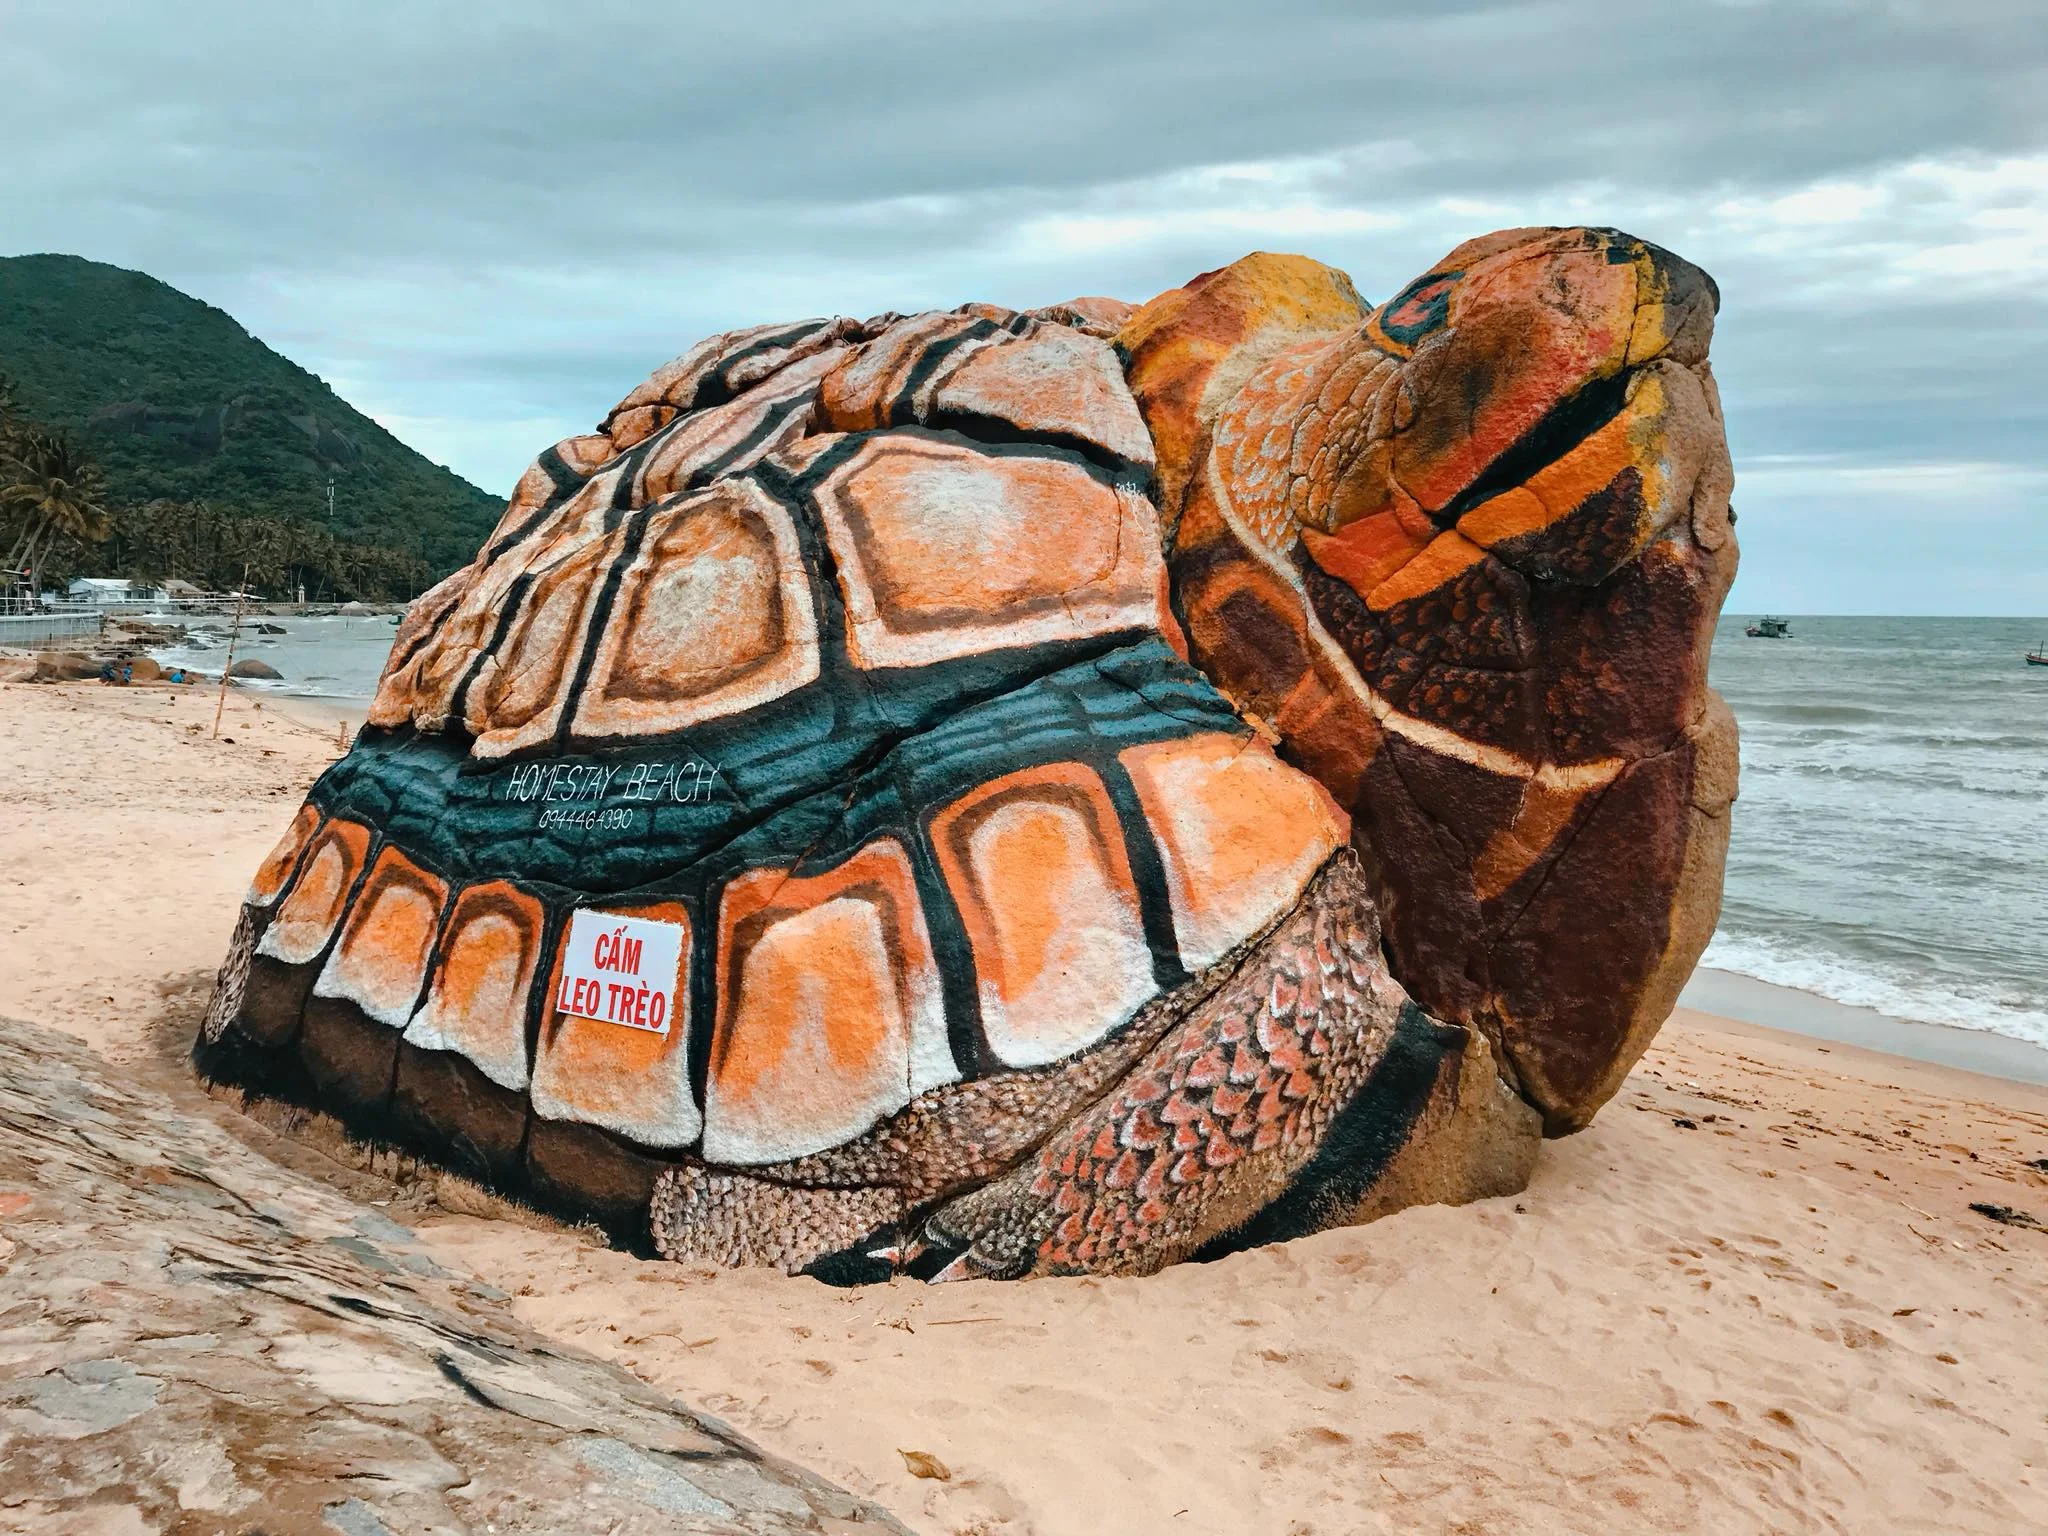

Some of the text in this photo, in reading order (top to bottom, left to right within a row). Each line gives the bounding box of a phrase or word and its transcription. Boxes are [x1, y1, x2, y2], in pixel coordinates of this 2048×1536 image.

[505, 762, 721, 802] HOMESTAY BEACH
[539, 809, 632, 829] 0944464390
[594, 926, 643, 975] CẤM
[559, 976, 665, 1029] LEO TRÈO
